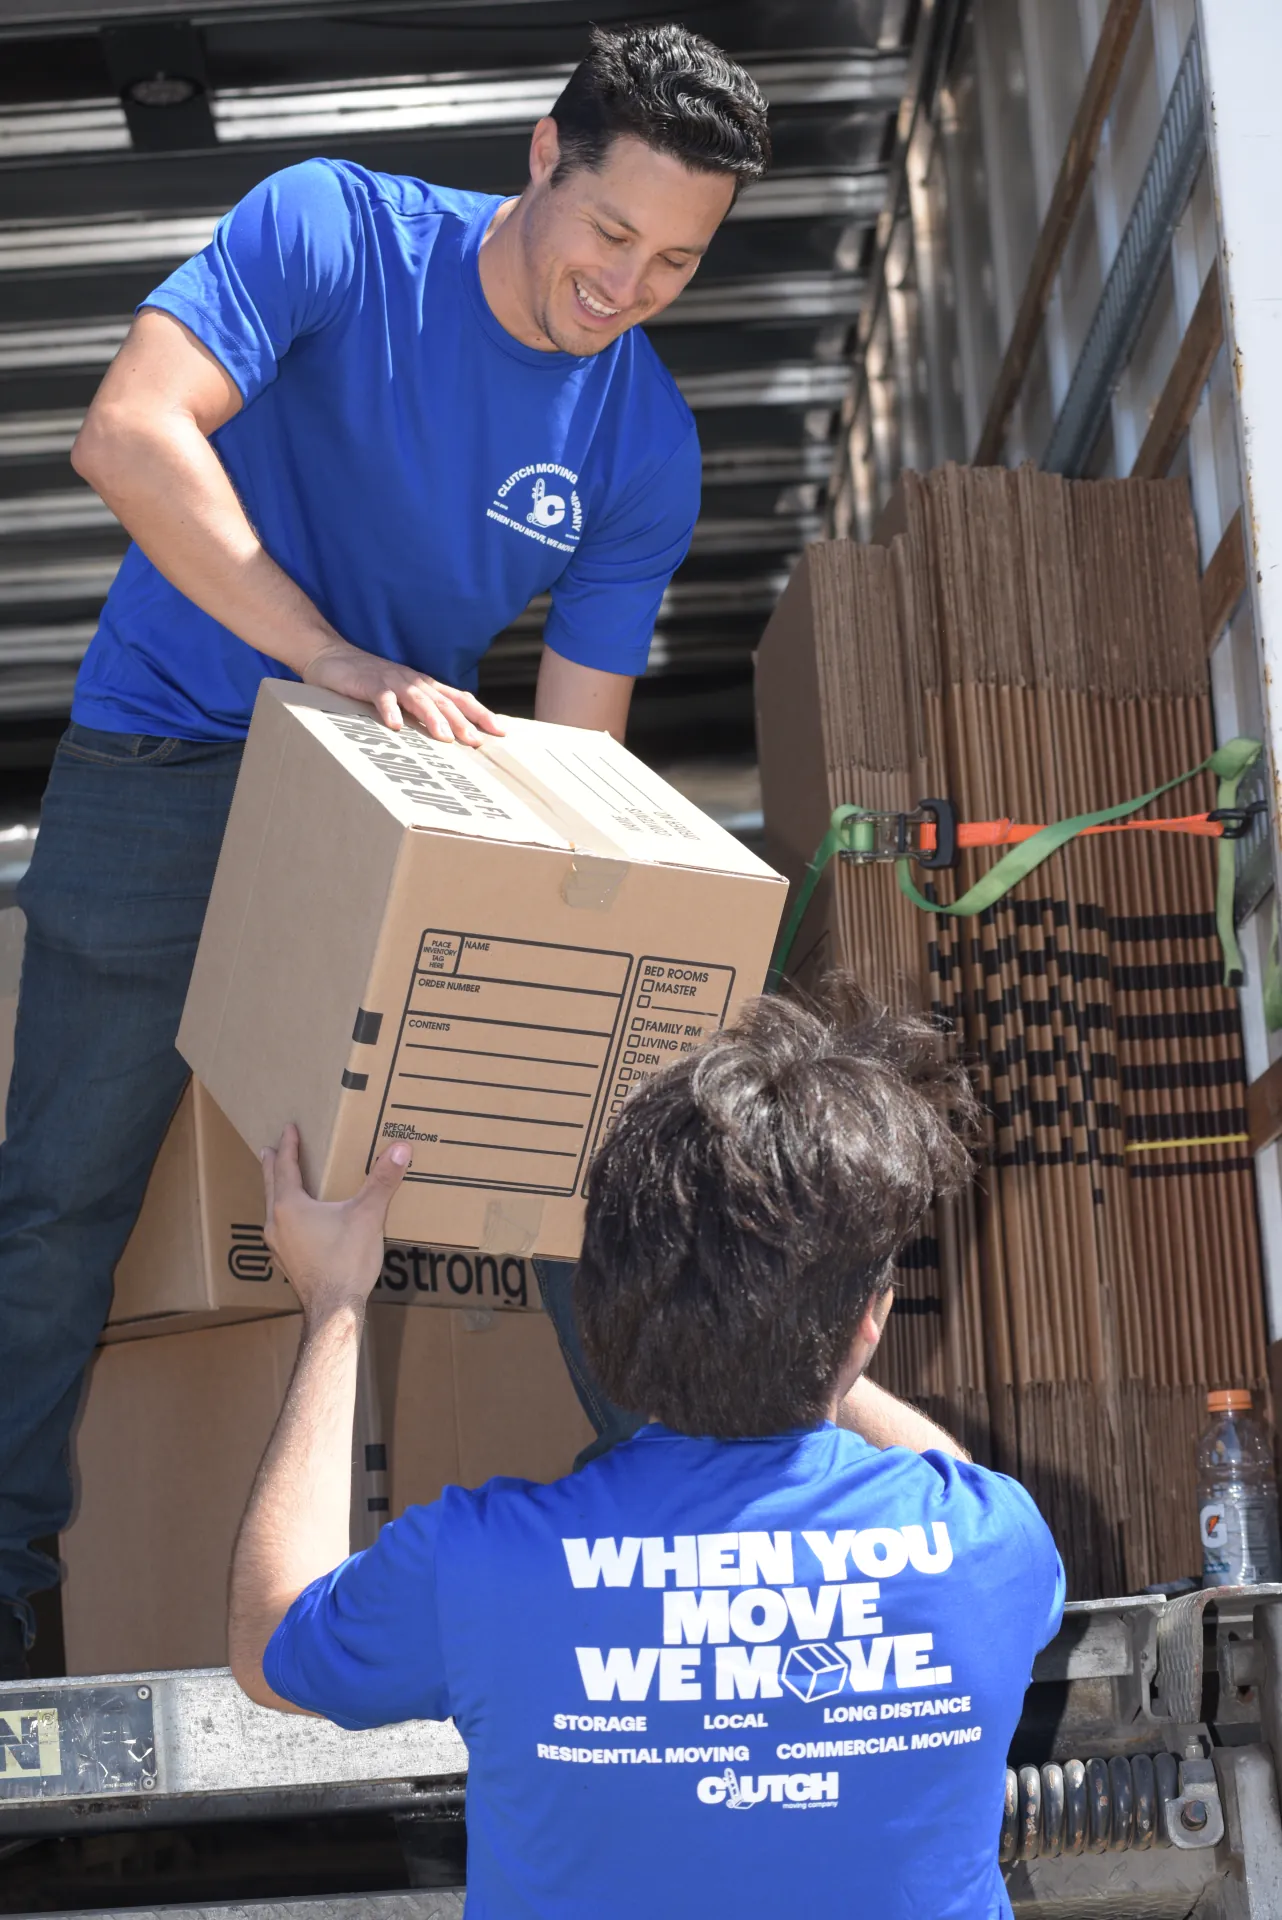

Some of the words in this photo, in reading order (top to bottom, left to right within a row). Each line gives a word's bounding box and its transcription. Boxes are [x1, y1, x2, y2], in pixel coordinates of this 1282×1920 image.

[497, 464, 535, 498] CLUTCH
[536, 463, 578, 485] MOVING
[570, 490, 582, 532] MPANY
[486, 508, 509, 526] WHEN
[509, 519, 525, 533] YOU
[524, 527, 547, 544] MOVE,
[546, 537, 559, 549] WE
[321, 711, 401, 750] THIS
[358, 747, 446, 791] SIDE
[401, 788, 472, 816] UP
[437, 770, 494, 804] CUBIC
[474, 804, 513, 820] FT.
[423, 946, 457, 957] INVENTORY
[432, 940, 452, 948] PLACE
[464, 940, 490, 951] NAME
[644, 965, 664, 977] BED
[667, 968, 709, 983] ROOMS
[418, 978, 446, 989] ORDER
[446, 981, 480, 993] NUMBER
[654, 982, 697, 996] MASTER
[408, 1019, 451, 1031] CONTENTS
[644, 1020, 683, 1035] FAMILY
[641, 1037, 678, 1051] LIVING
[637, 1052, 660, 1065] DEN
[382, 1129, 438, 1142] INSTRUCTIONS
[383, 1122, 416, 1132] SPECIAL
[1200, 1503, 1228, 1549] G
[561, 1530, 794, 1588] WHEN
[801, 1521, 954, 1582] YOU
[663, 1581, 883, 1645] MOVE
[575, 1647, 701, 1701] WE
[553, 1713, 648, 1732] STORAGE
[703, 1713, 769, 1730] LOCAL
[823, 1705, 877, 1724] LONG
[880, 1696, 972, 1720] DISTANCE
[536, 1743, 662, 1764] RESIDENTIAL
[665, 1745, 750, 1763] MOVING
[776, 1735, 908, 1760] COMMERCIAL
[911, 1726, 982, 1750] MOVING
[782, 1802, 807, 1810] moving
[807, 1801, 838, 1809] company
